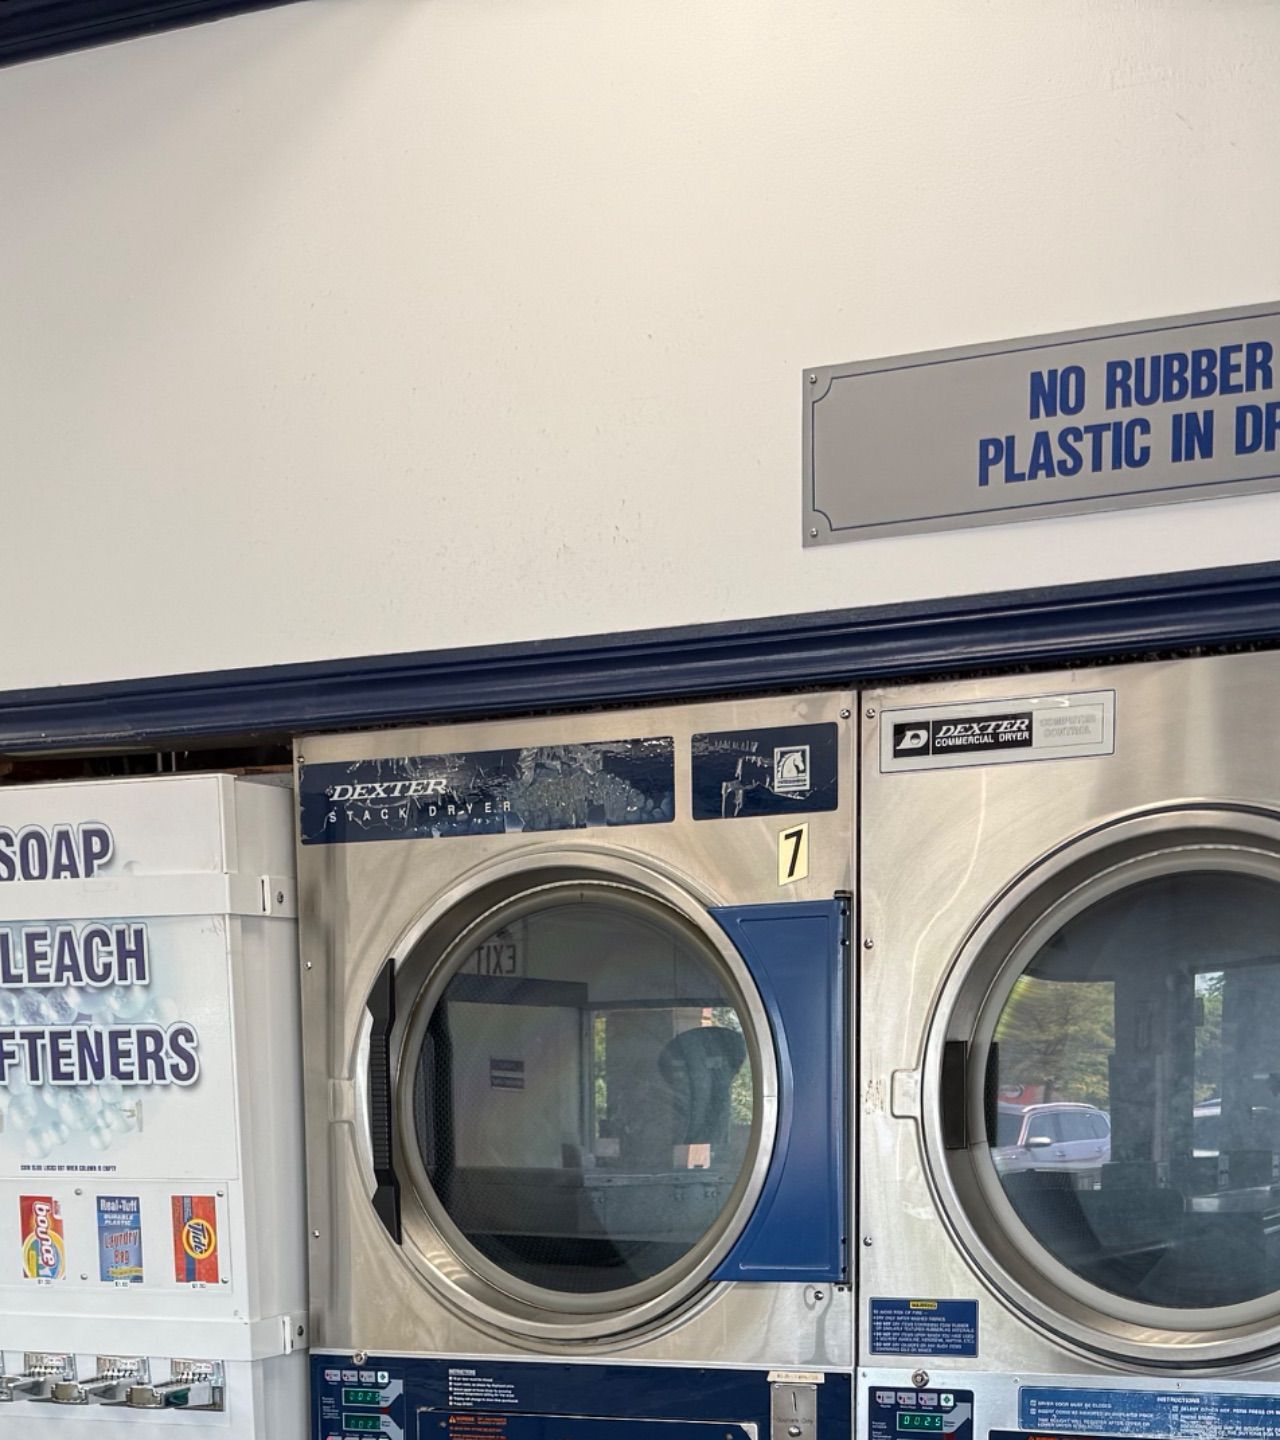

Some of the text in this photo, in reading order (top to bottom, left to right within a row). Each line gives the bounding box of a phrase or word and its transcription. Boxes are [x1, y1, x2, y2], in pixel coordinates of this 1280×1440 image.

[1030, 366, 1084, 418] NO
[1105, 341, 1272, 408] RUBBER
[979, 418, 1150, 485] PLASTIC
[1171, 410, 1213, 461] IN
[935, 731, 1030, 747] COMMERCIAL DRYER
[936, 718, 1030, 738] DEXTER
[330, 779, 447, 801] DEXTER
[329, 801, 511, 823] STACK DRYER
[784, 829, 803, 877] 7
[188, 1223, 208, 1255] Tide
[904, 1415, 941, 1426] 0025
